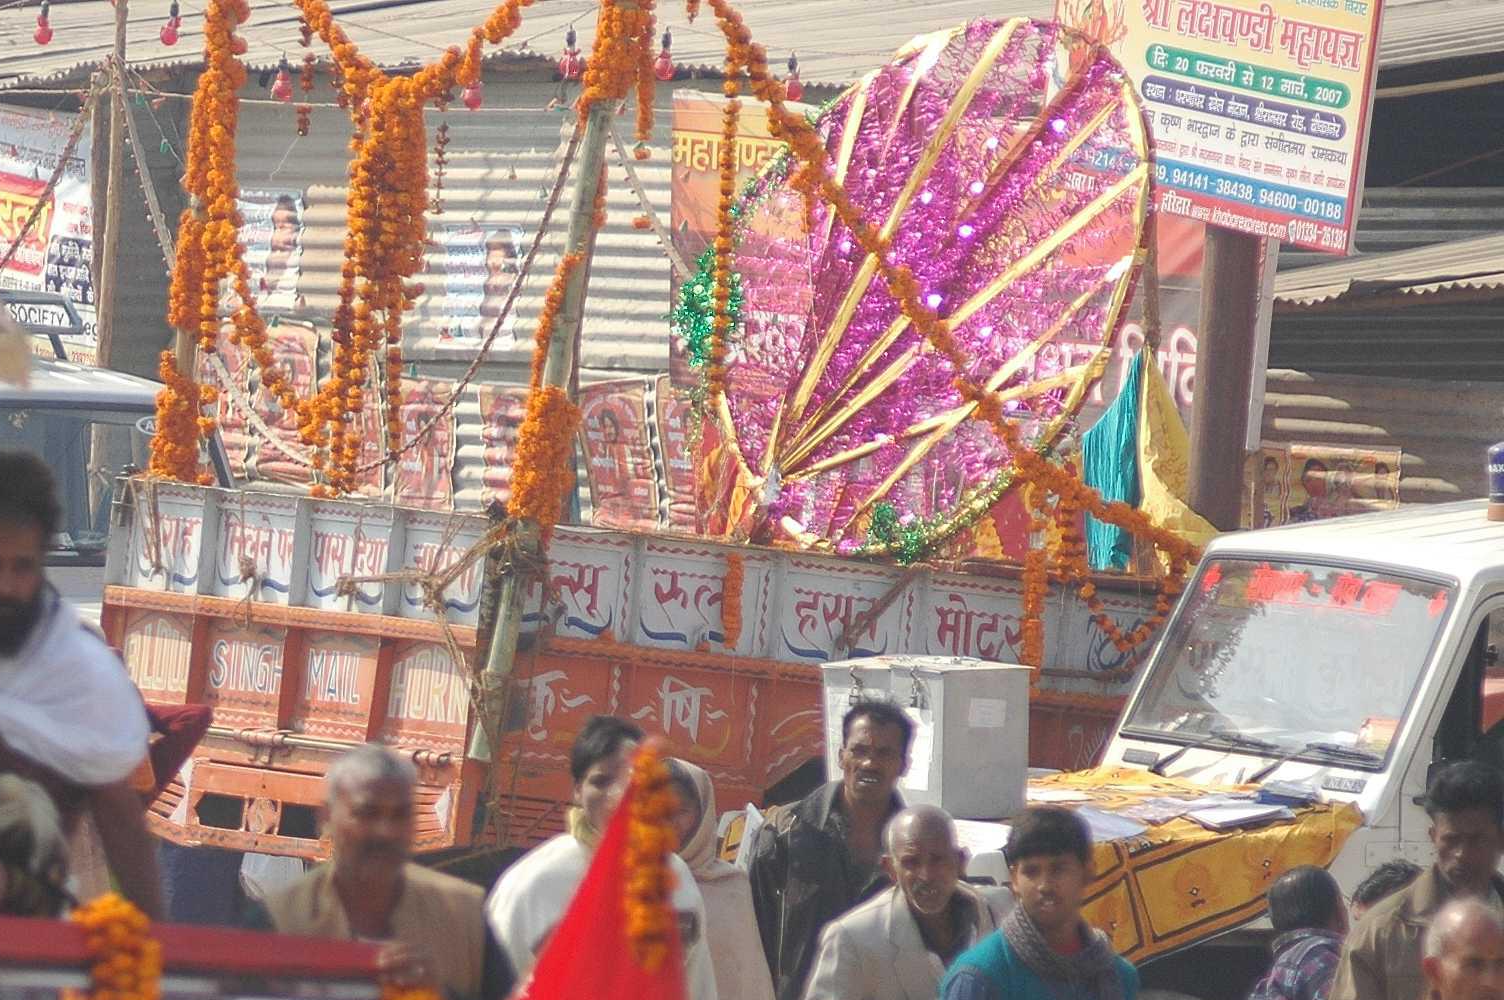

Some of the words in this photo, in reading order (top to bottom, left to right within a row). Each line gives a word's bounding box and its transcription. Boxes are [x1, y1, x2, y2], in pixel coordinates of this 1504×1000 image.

[1279, 15, 1366, 72] महायज्ञ
[1175, 56, 1189, 71] 20
[1196, 56, 1236, 83] फरवरी
[1243, 64, 1254, 86] से
[1261, 74, 1273, 90] 12
[1316, 85, 1342, 105] 2007
[1173, 168, 1257, 205] 94141-38438,
[1260, 189, 1342, 220] 94600-00188
[306, 648, 361, 706] MAIL
